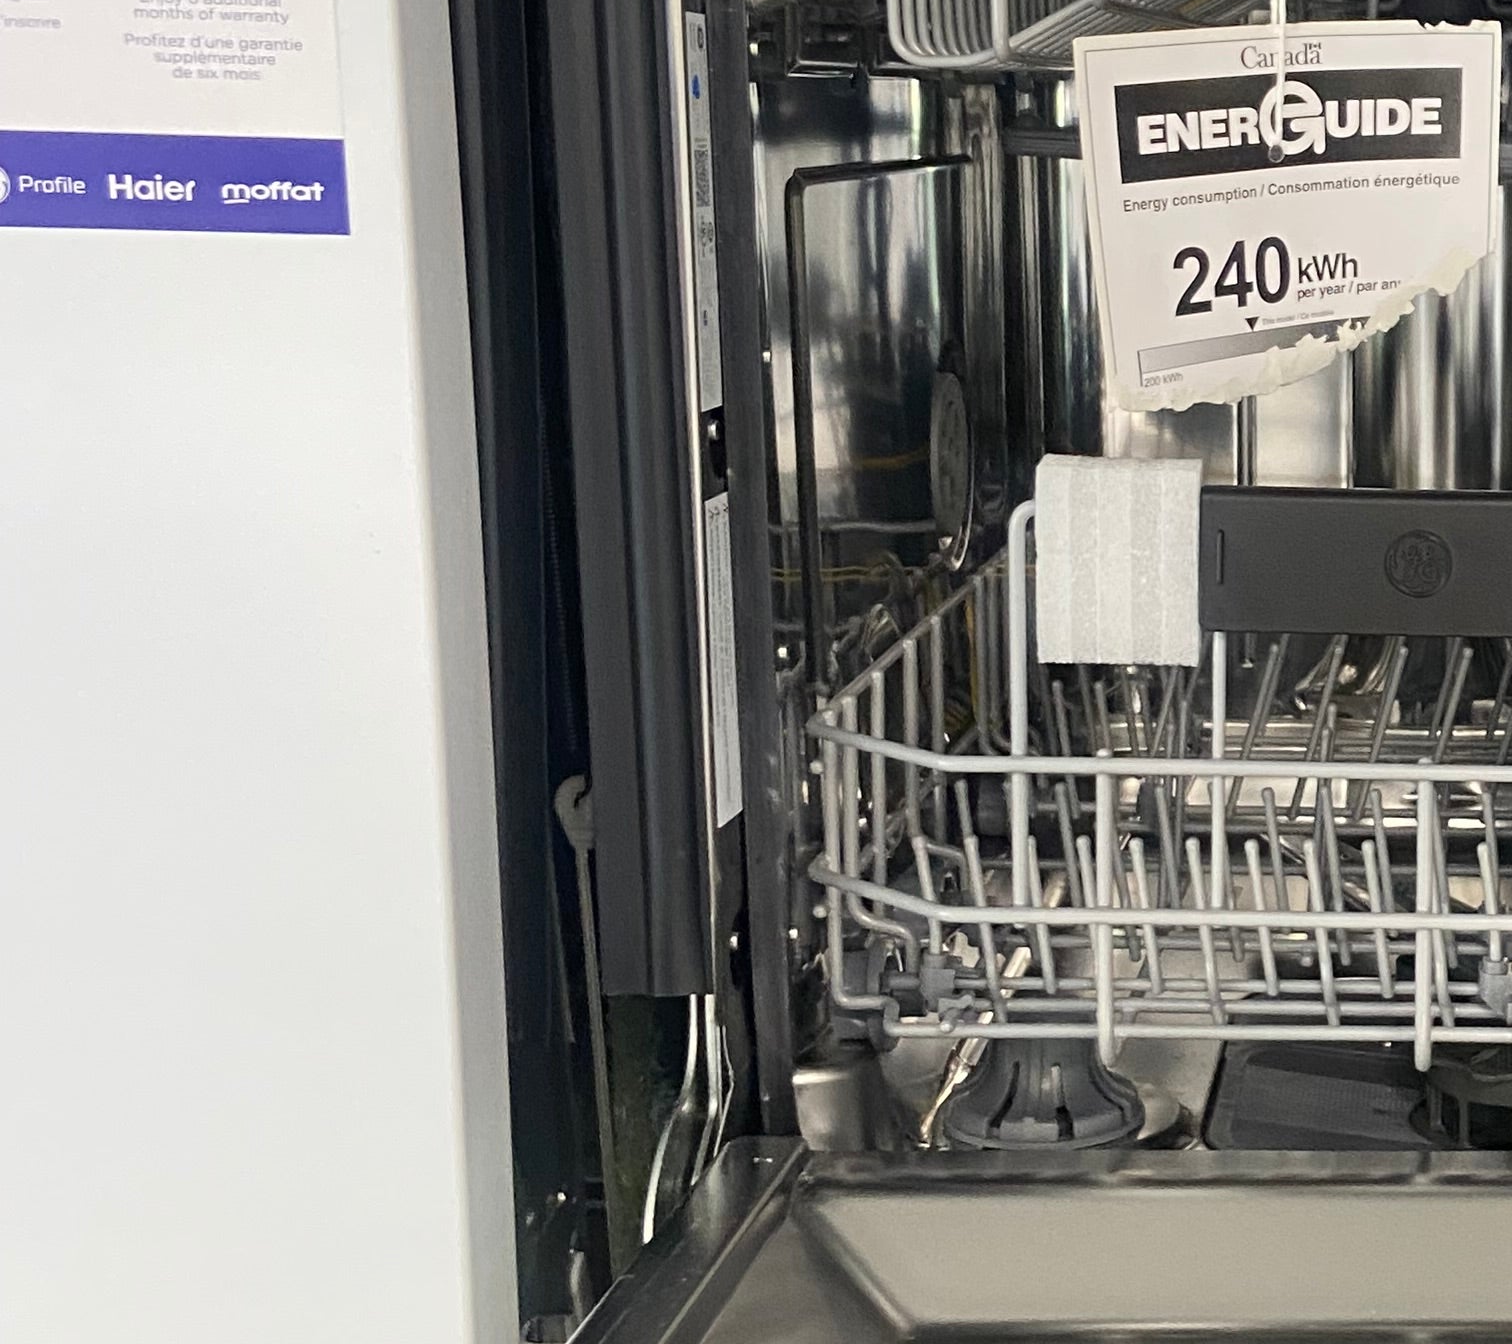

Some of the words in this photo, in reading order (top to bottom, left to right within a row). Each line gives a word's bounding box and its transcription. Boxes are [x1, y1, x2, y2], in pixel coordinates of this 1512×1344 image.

[134, 5, 194, 20] months
[199, 6, 215, 21] of
[219, 9, 290, 26] warranty
[124, 33, 185, 48] Profitez
[239, 37, 304, 53] garantie
[172, 65, 193, 79] de
[197, 66, 218, 80] six
[223, 67, 261, 81] mois
[18, 175, 86, 194] Profile
[108, 174, 196, 202] Haier
[221, 179, 324, 205] moffat
[1123, 197, 1168, 213] Energy
[1172, 185, 1257, 209] consumption
[1268, 174, 1370, 197] Consommation
[1374, 171, 1460, 191] énergétique
[1173, 236, 1290, 316] 240
[1298, 253, 1358, 284] kWh
[1297, 287, 1316, 302] per
[1319, 284, 1346, 299] year
[1356, 281, 1378, 295] par
